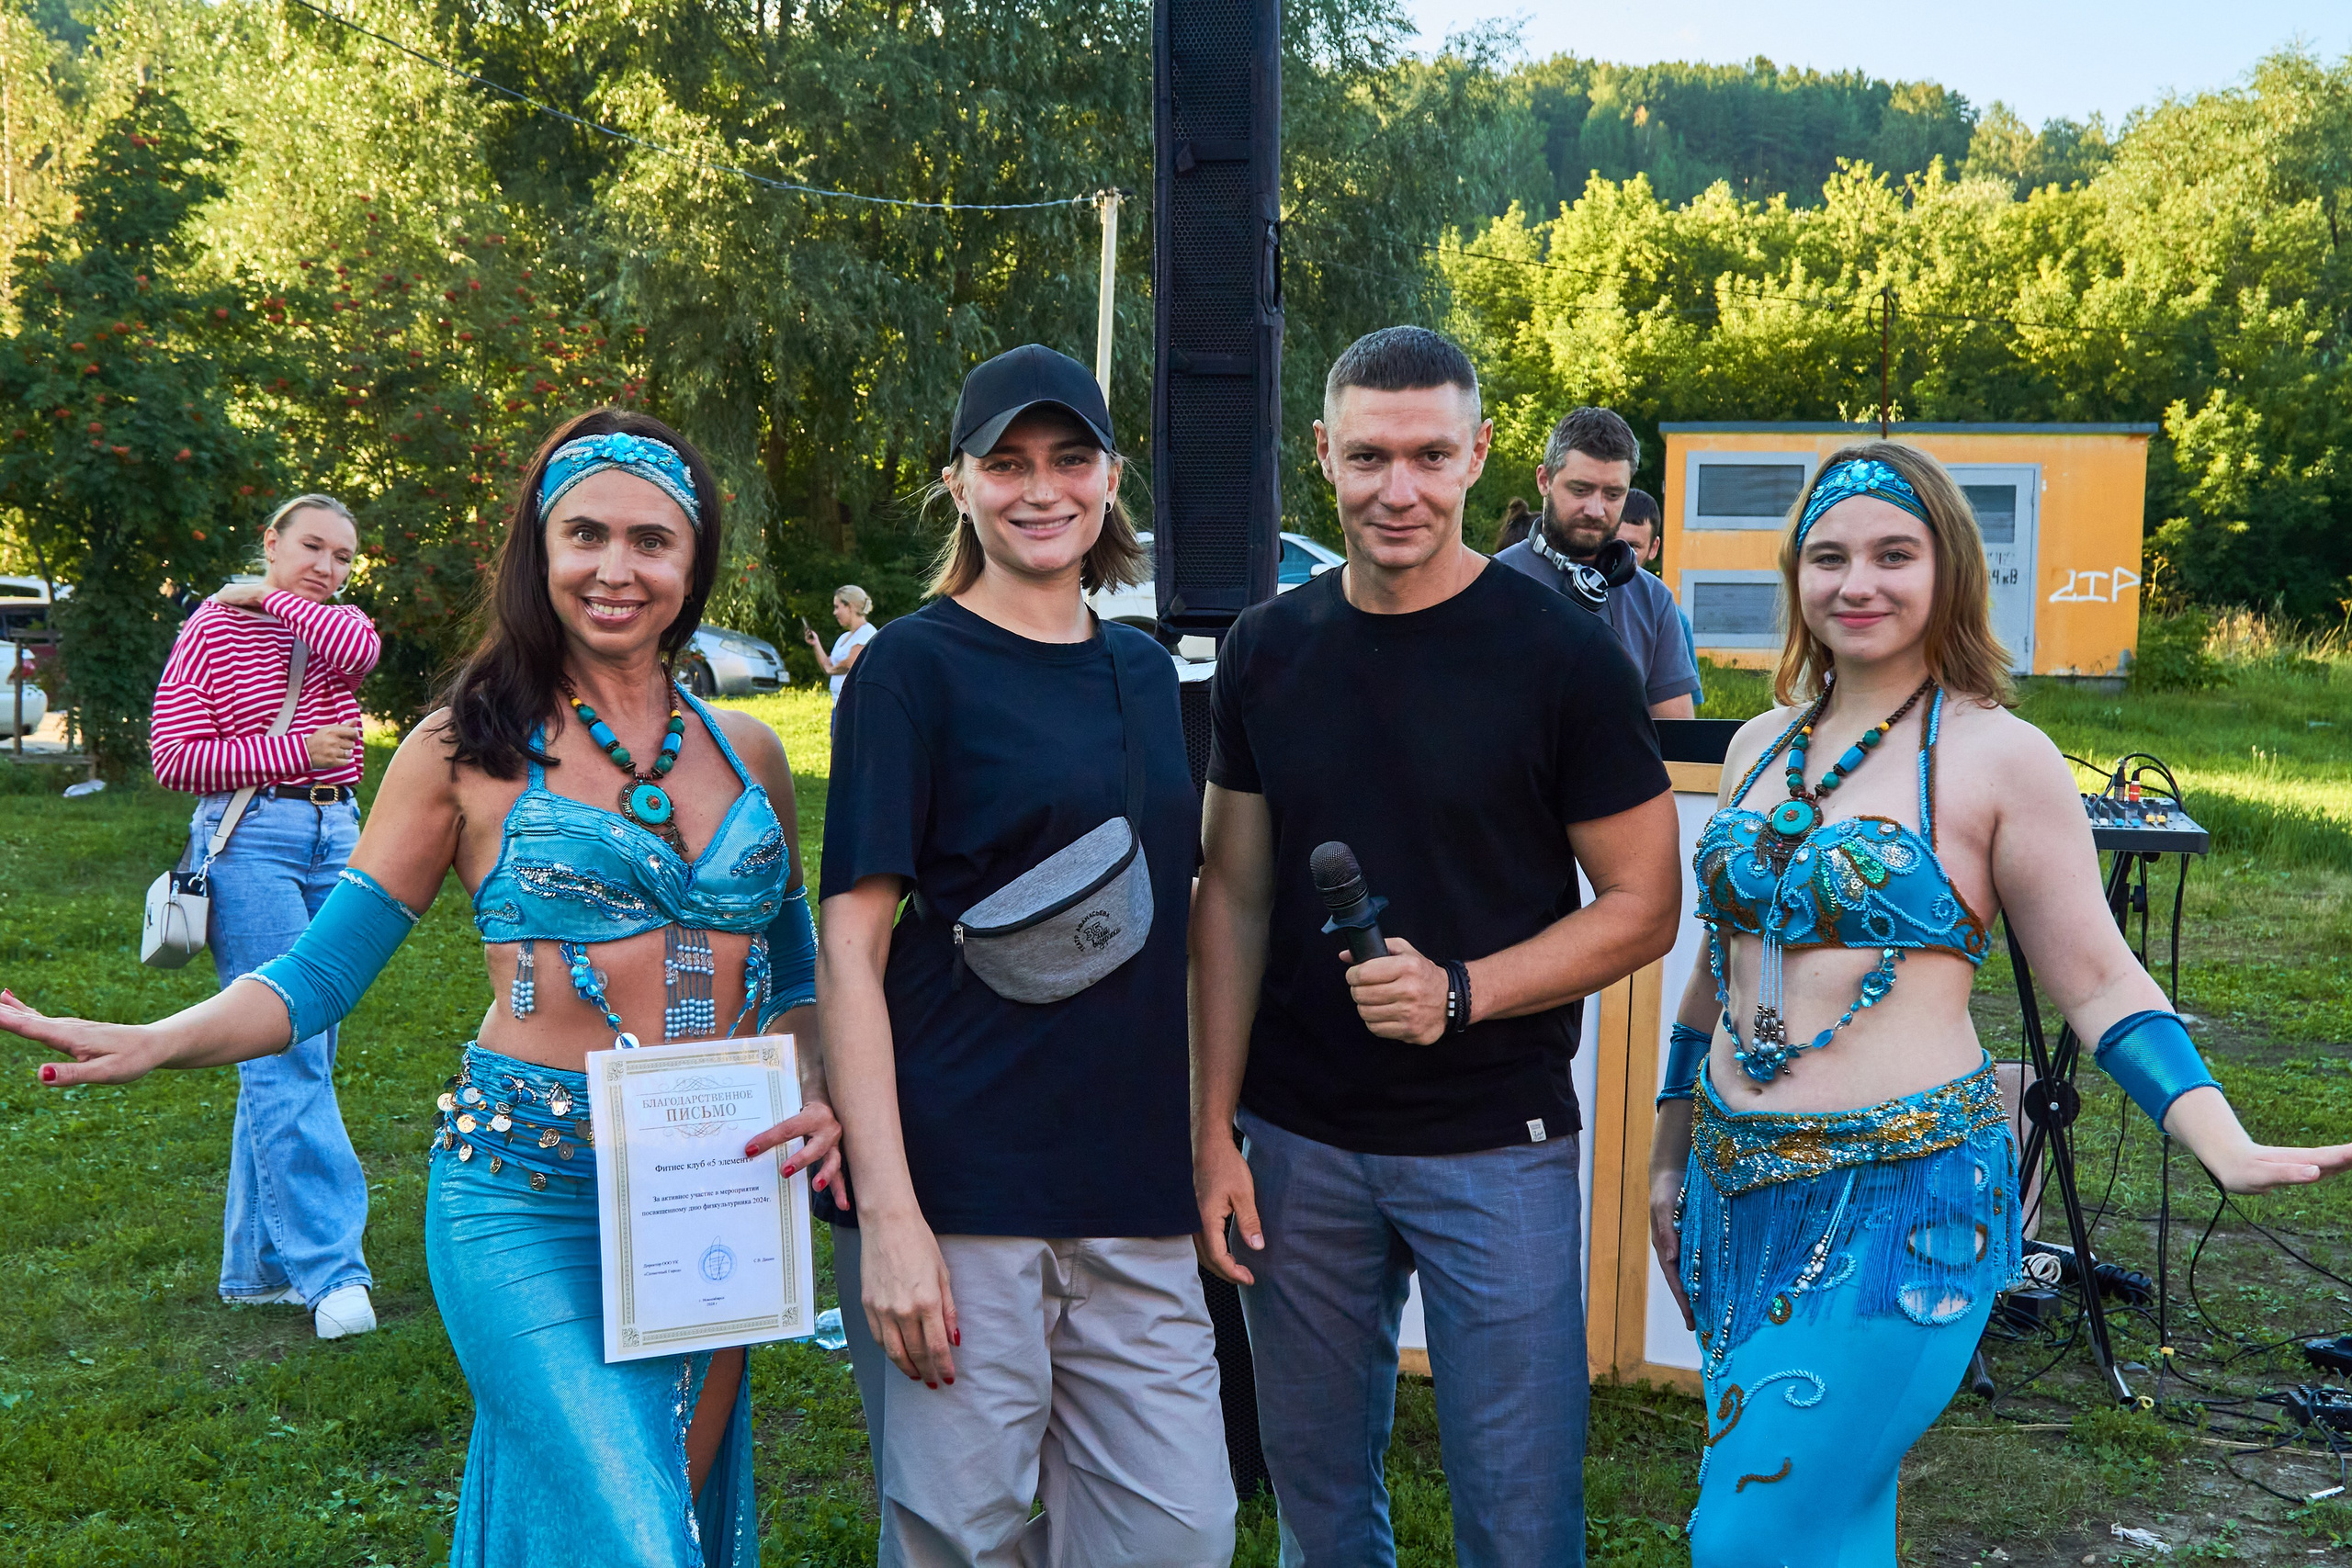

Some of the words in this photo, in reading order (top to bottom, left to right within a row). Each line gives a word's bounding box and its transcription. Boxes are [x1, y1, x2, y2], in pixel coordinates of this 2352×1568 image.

[1084, 921, 1103, 942] 35
[642, 1089, 753, 1109] БЛАГОДАРСТВЕННОЕ
[666, 1102, 737, 1122] ПИСЬМО
[655, 1163, 685, 1173] Фитнес
[686, 1159, 706, 1170] клуб
[707, 1158, 717, 1168] «5
[662, 1193, 689, 1201] активное
[690, 1190, 714, 1200] участие
